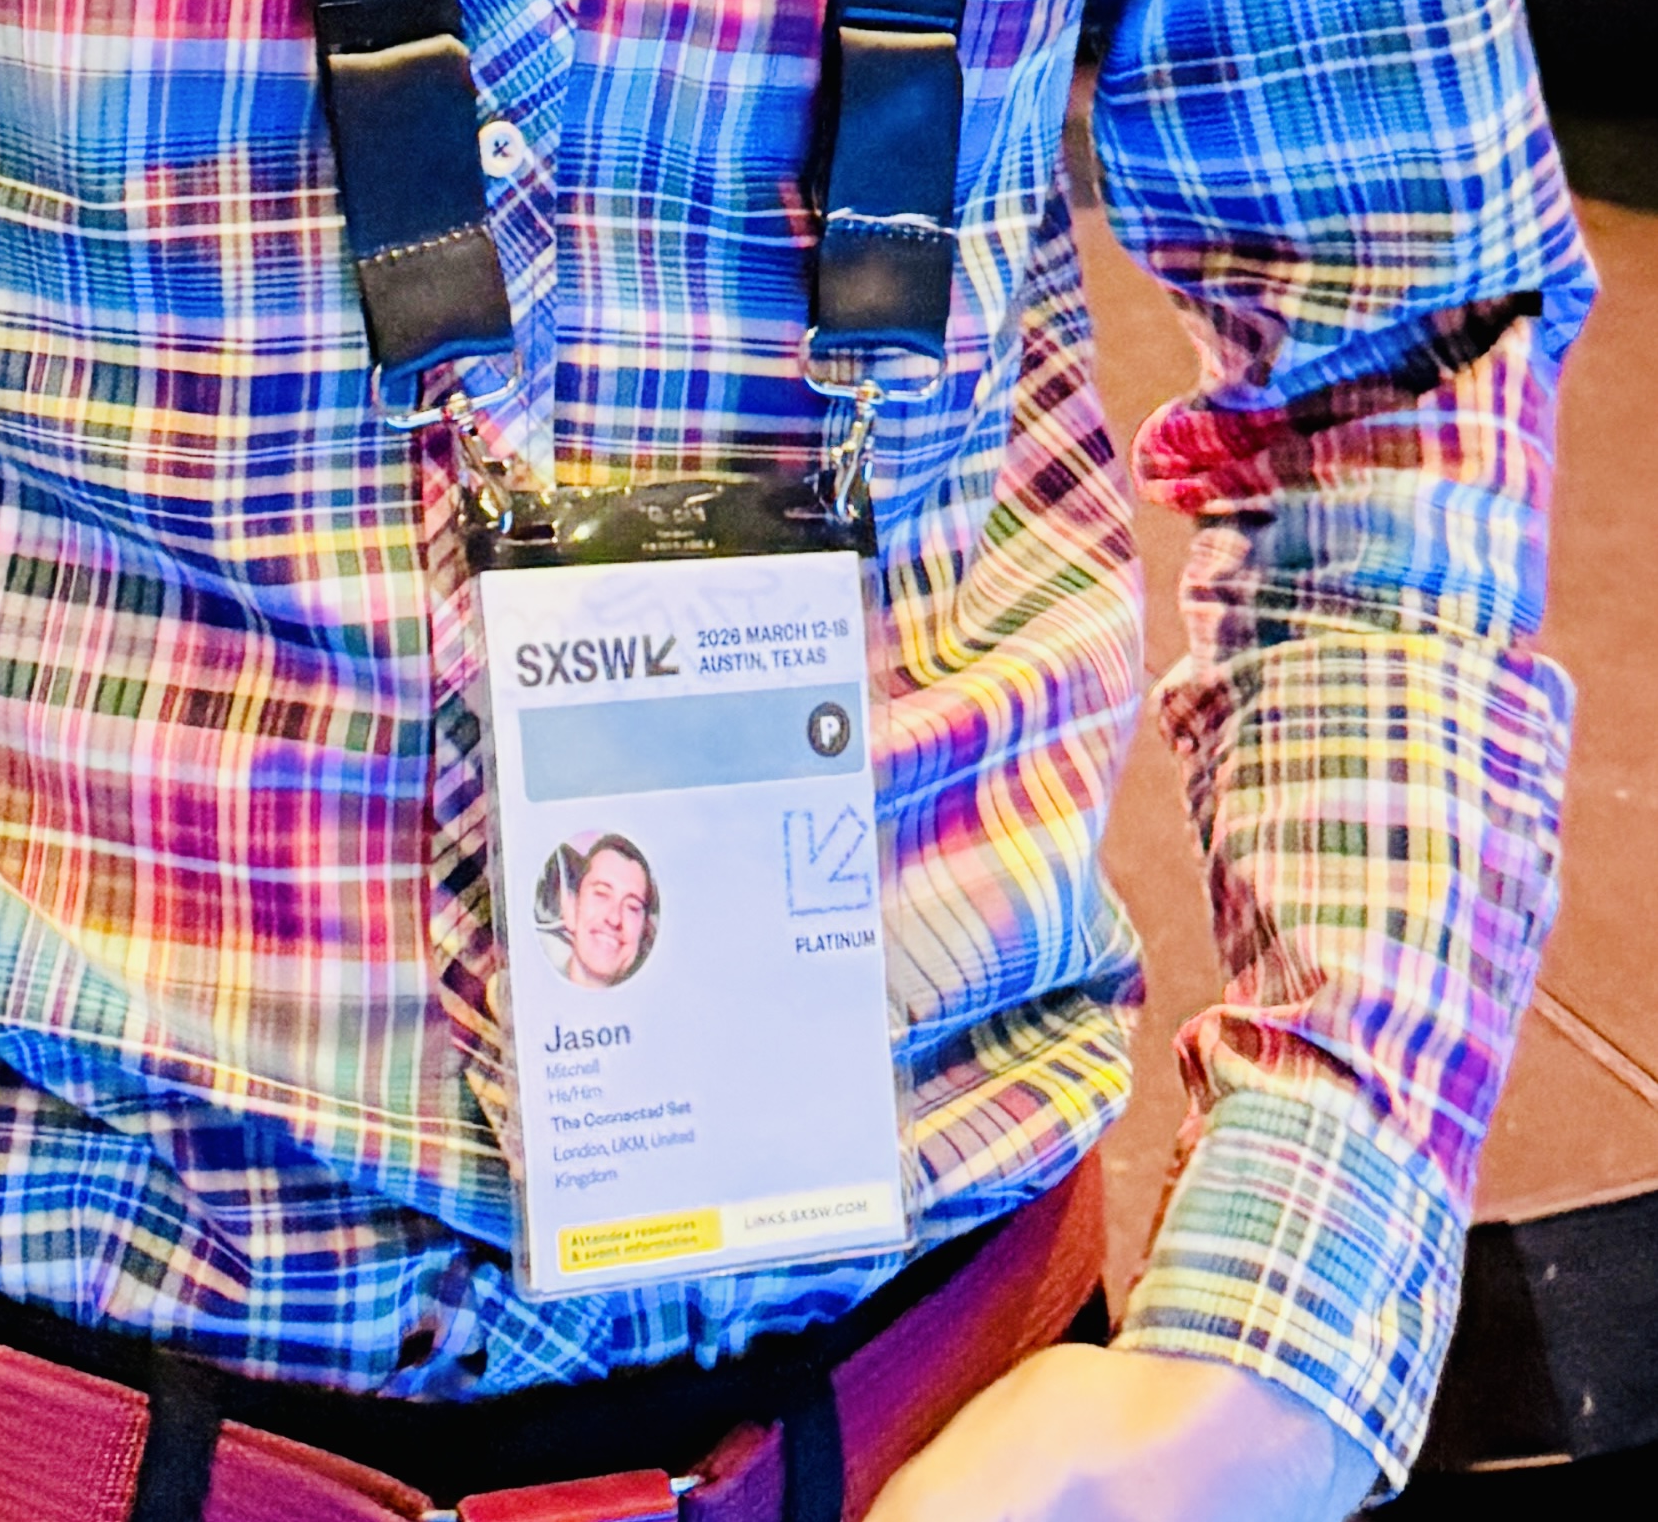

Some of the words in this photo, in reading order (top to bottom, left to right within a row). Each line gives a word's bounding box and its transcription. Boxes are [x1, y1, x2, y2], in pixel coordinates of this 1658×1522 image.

[697, 628, 741, 648] 2026
[746, 623, 807, 643] MARCH
[516, 635, 637, 687] SXSW
[699, 652, 768, 675] AUSTIN,
[772, 647, 827, 668] TEXAS
[819, 715, 841, 748] P
[795, 930, 876, 954] PLATINUM
[545, 1024, 632, 1053] Jason
[551, 1116, 580, 1132] The
[584, 1103, 663, 1127] Connected
[666, 1101, 691, 1115] Set
[650, 1128, 695, 1148] United
[555, 1169, 618, 1189] Kingdom
